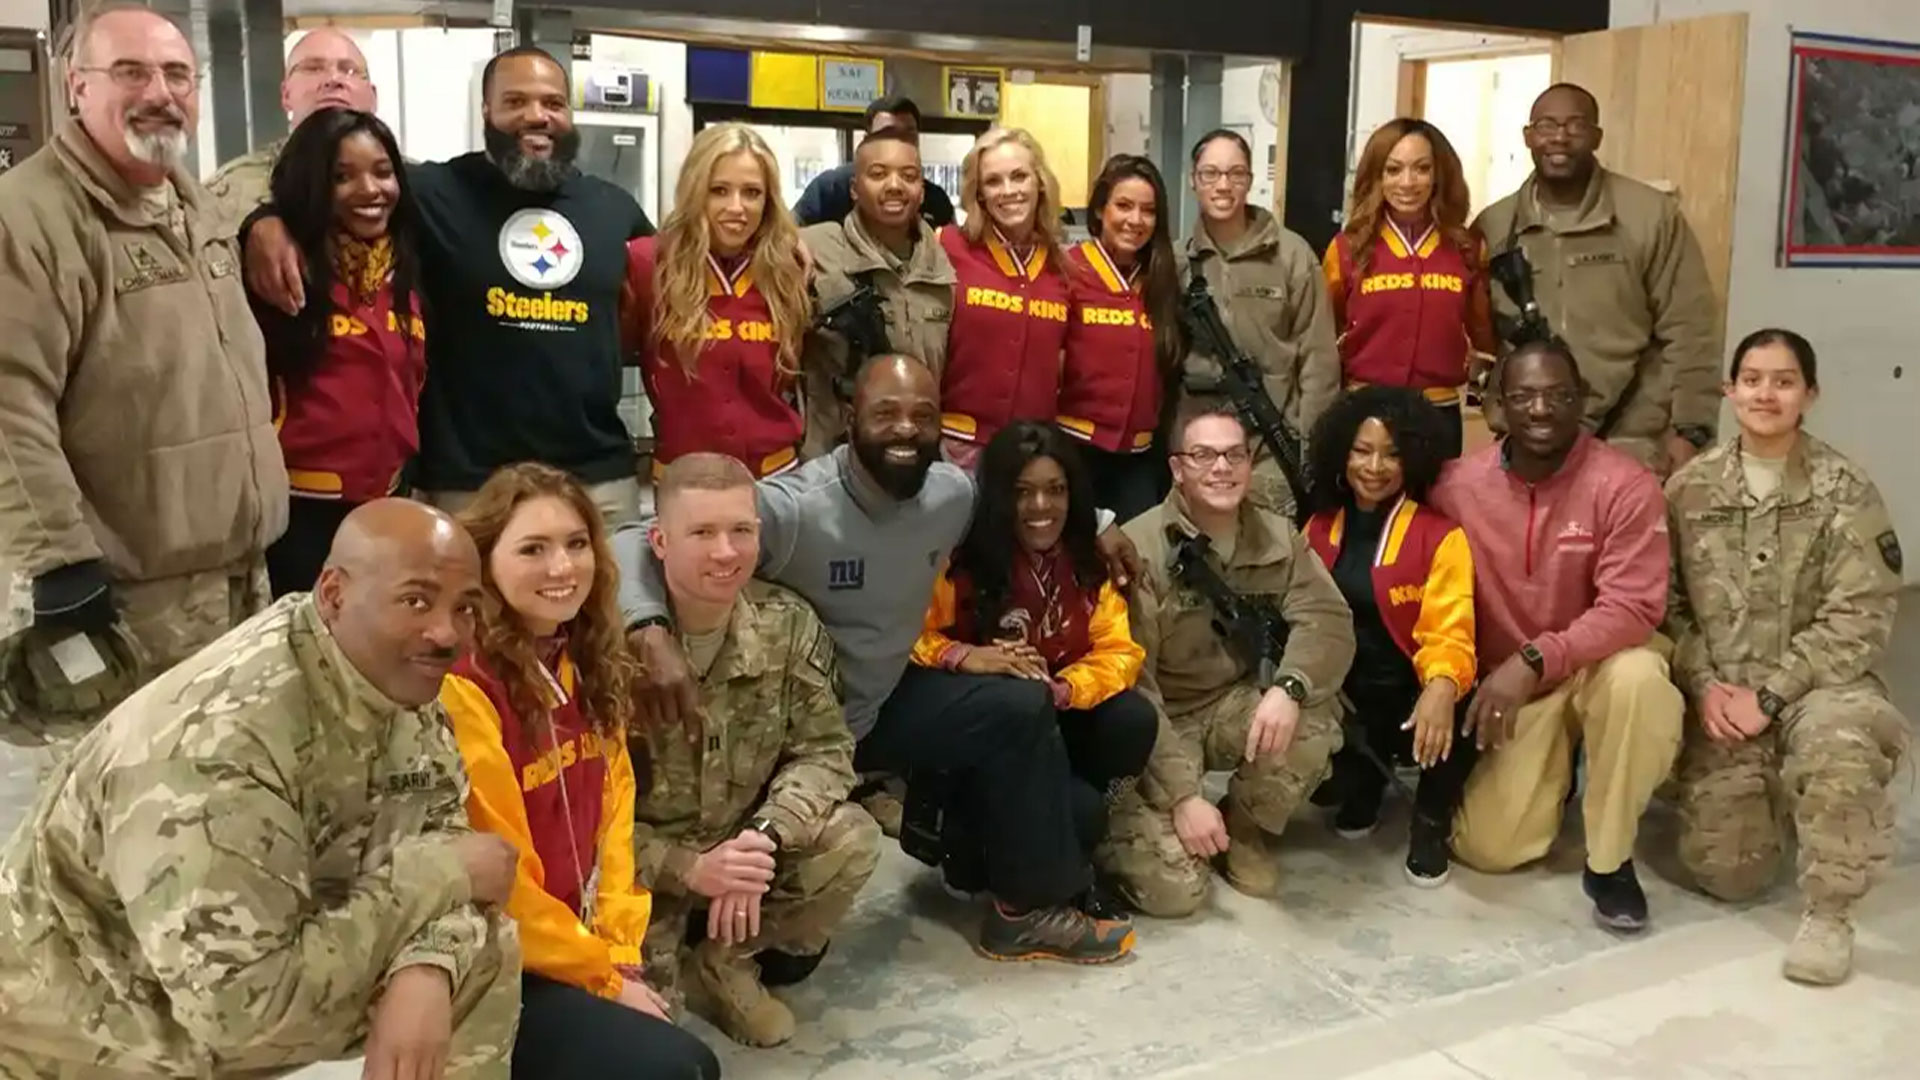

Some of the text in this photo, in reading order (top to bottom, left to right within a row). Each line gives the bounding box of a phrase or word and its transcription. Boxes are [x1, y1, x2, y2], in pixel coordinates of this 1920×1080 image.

[1361, 272, 1463, 296] REDS KINS
[486, 286, 589, 323] Steelers
[966, 286, 1024, 314] REDS
[1028, 299, 1068, 323] KINS
[1082, 307, 1136, 326] REDS
